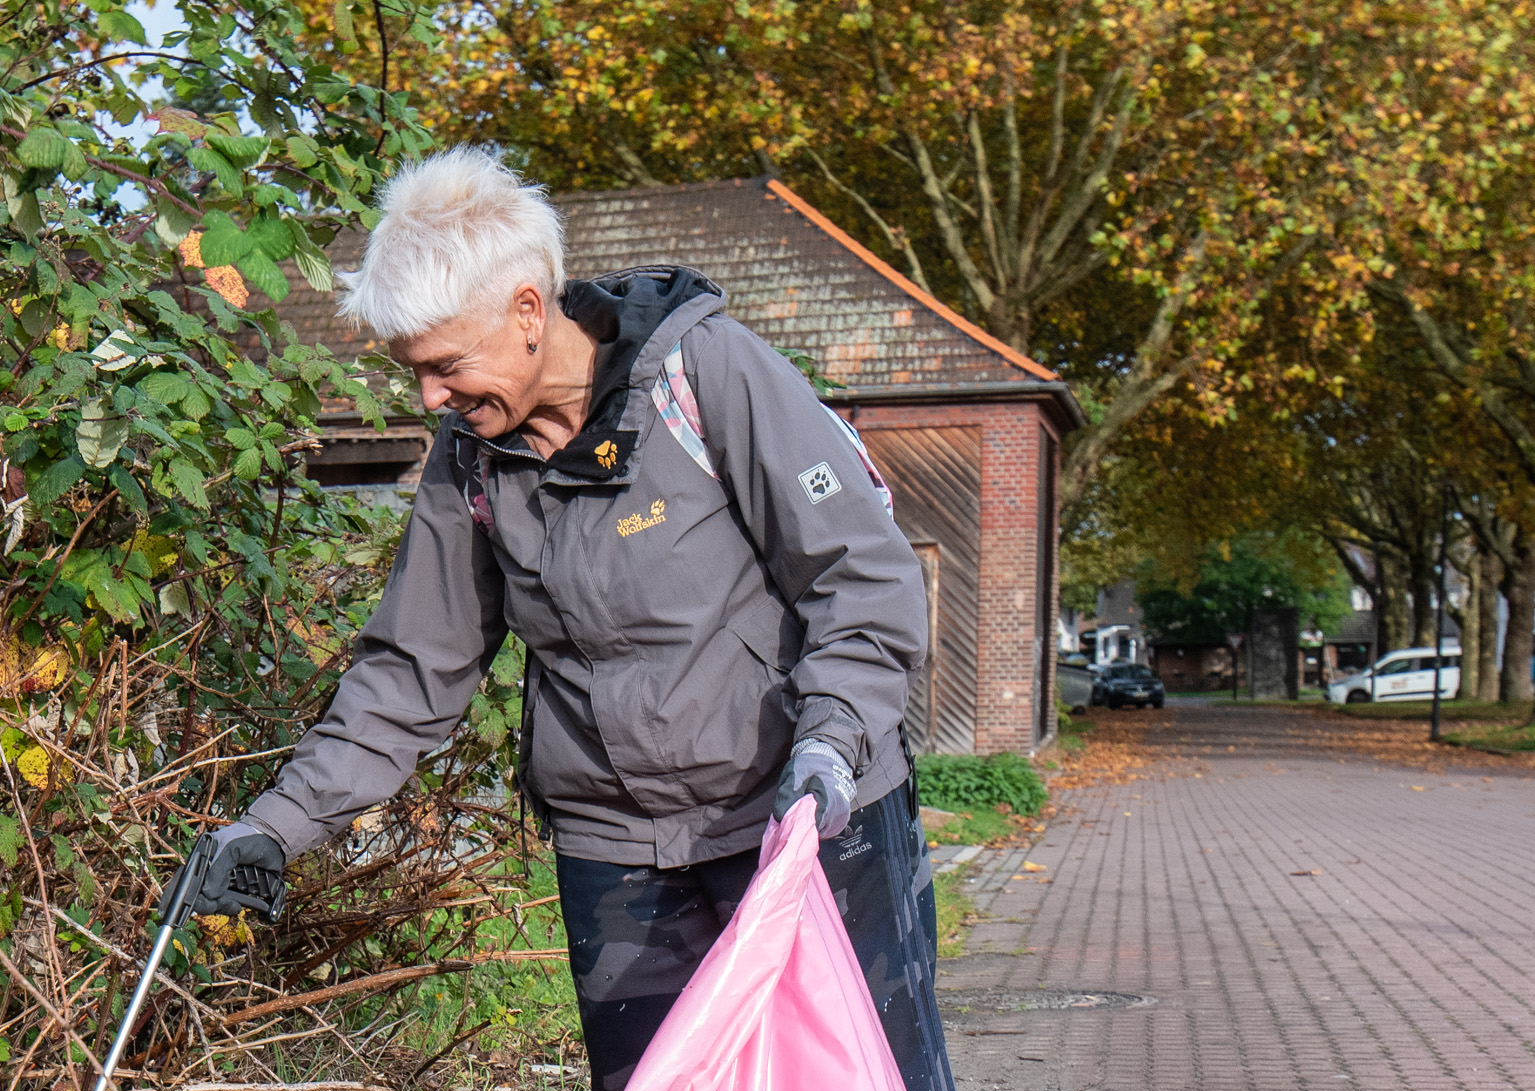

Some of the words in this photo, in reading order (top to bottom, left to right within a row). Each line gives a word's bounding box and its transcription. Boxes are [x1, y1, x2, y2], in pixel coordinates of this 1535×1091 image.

[617, 513, 643, 529] Jack
[617, 514, 667, 537] Wolfskin
[839, 841, 873, 861] adidas
